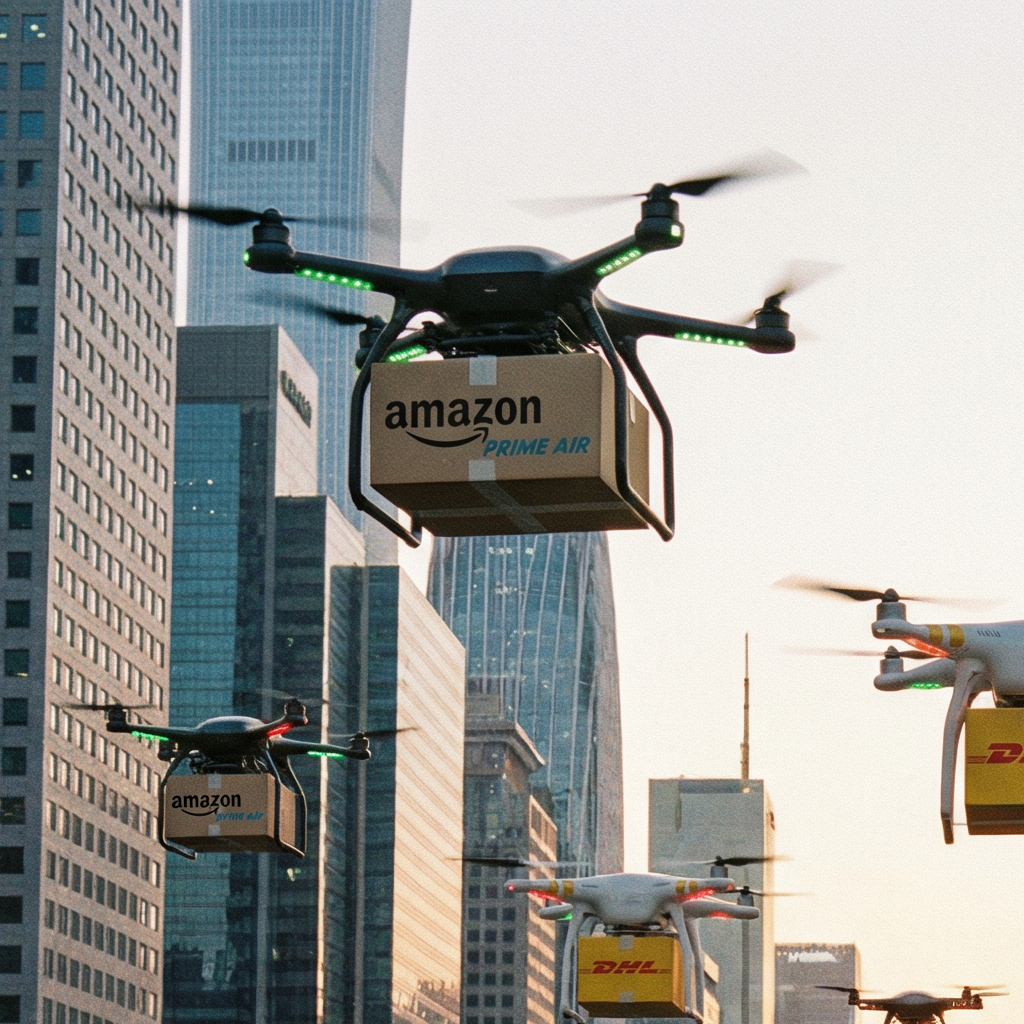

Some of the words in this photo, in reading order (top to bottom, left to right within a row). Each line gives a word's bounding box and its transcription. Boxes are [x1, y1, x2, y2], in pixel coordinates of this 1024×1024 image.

[384, 395, 542, 430] amazon
[482, 437, 551, 457] PRIME
[552, 436, 591, 454] AIR
[171, 794, 242, 809] amazon
[592, 960, 659, 974] DHL
